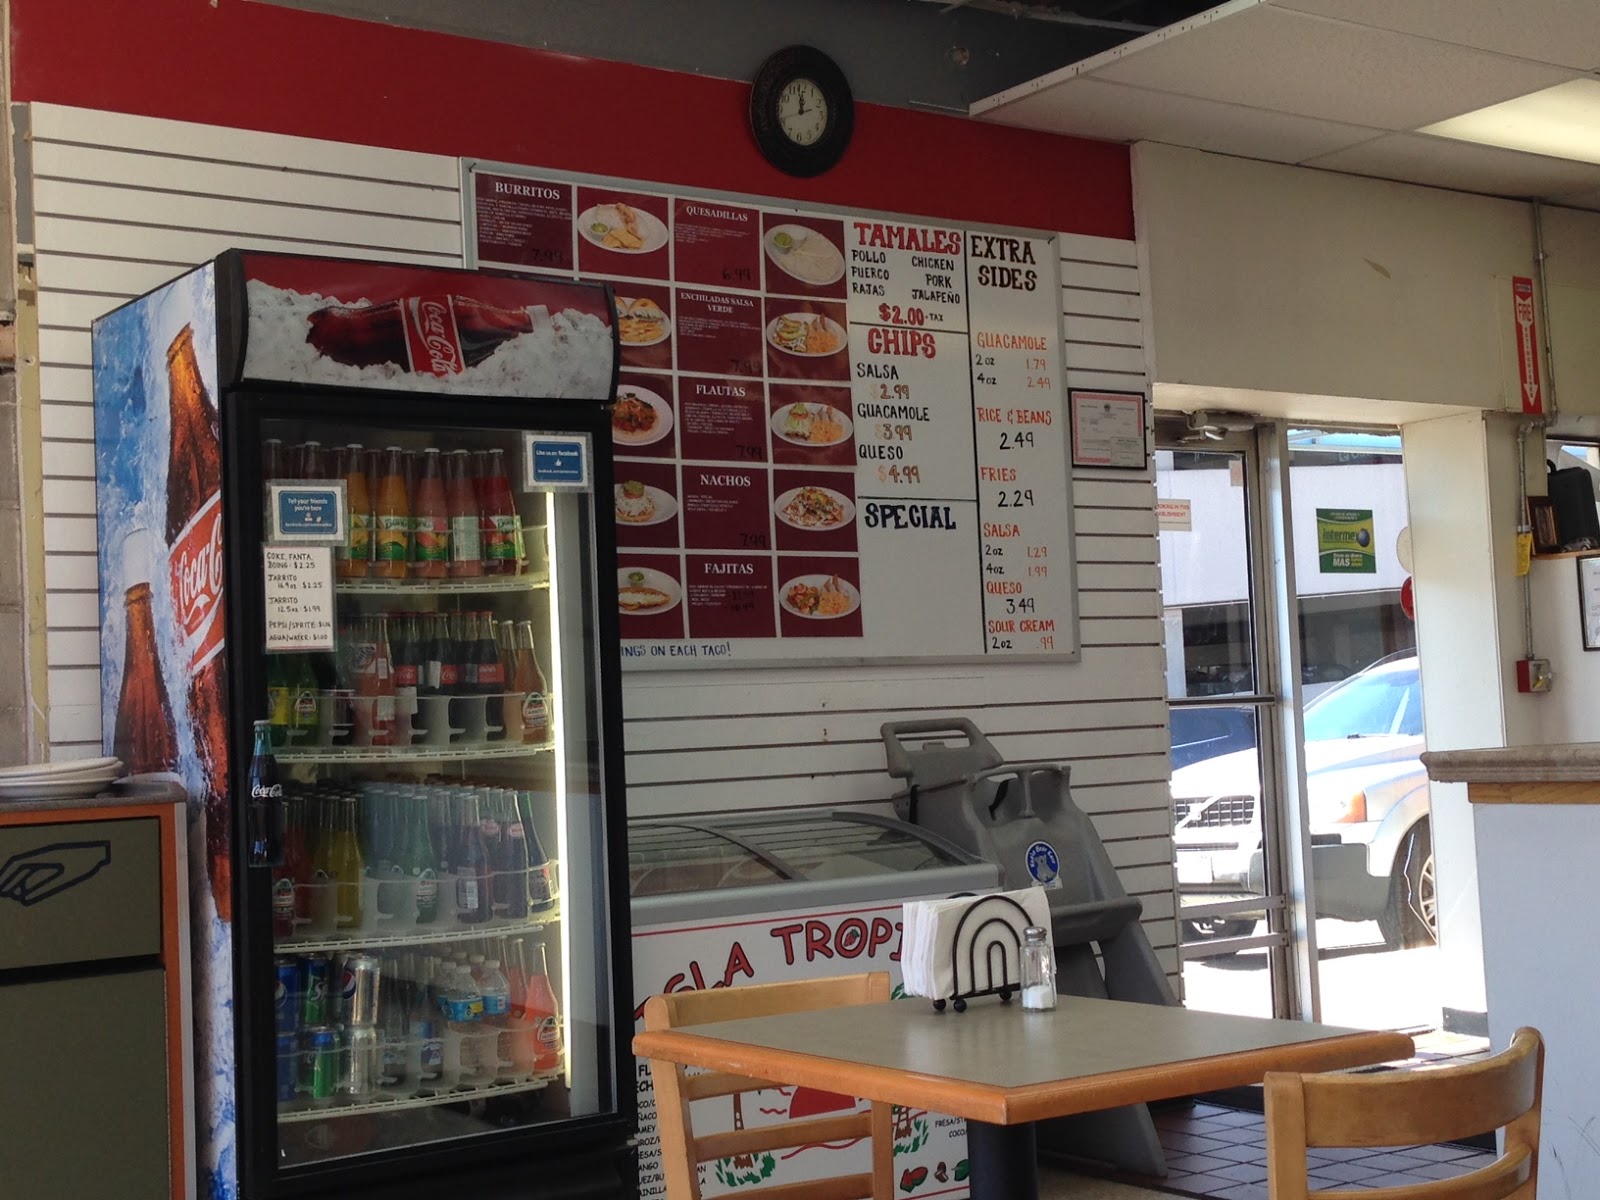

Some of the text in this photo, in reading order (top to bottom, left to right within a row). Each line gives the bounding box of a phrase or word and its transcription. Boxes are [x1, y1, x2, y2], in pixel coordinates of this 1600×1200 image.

[816, 98, 822, 108] 2
[796, 132, 802, 141] 6
[495, 181, 561, 200] BURRITOS
[685, 205, 748, 222] QUESADILLAS
[853, 222, 961, 255] TAMALES
[971, 235, 1036, 265] EXTRA
[851, 249, 954, 271] POLLO CHICKEN
[851, 266, 952, 289] PUERCO PORK
[977, 265, 1037, 291] SIDES
[852, 282, 885, 297] RAJAS
[681, 292, 754, 307] ENCHILADAS SALSA
[707, 304, 733, 314] VERDE
[879, 302, 924, 326] $2.00
[867, 328, 936, 359] CHIPS
[977, 332, 1047, 351] GUACAMOLE
[856, 362, 899, 380] SALSA
[696, 384, 746, 397] FLAUTAS
[869, 383, 910, 400] $2.99
[857, 402, 930, 422] GUACAMOLE
[976, 407, 1052, 425] RICE & BEANS
[874, 423, 912, 441] $3.99
[999, 431, 1034, 450] 2.49
[858, 444, 903, 460] QUESO
[700, 474, 751, 487] NACHOS
[878, 464, 920, 484] $4.99
[980, 466, 1016, 481] FRIES
[997, 489, 1034, 508] 2.29
[864, 502, 956, 530] SPECIAL
[983, 522, 1020, 538] SALSA
[704, 563, 754, 575] FAJITAS
[268, 574, 298, 582] JARRITO
[986, 581, 1022, 594] QUESO
[988, 619, 1055, 633] SOUR CREAM
[650, 645, 666, 656] ON
[669, 645, 697, 657] EACH
[701, 641, 731, 657] TACO!
